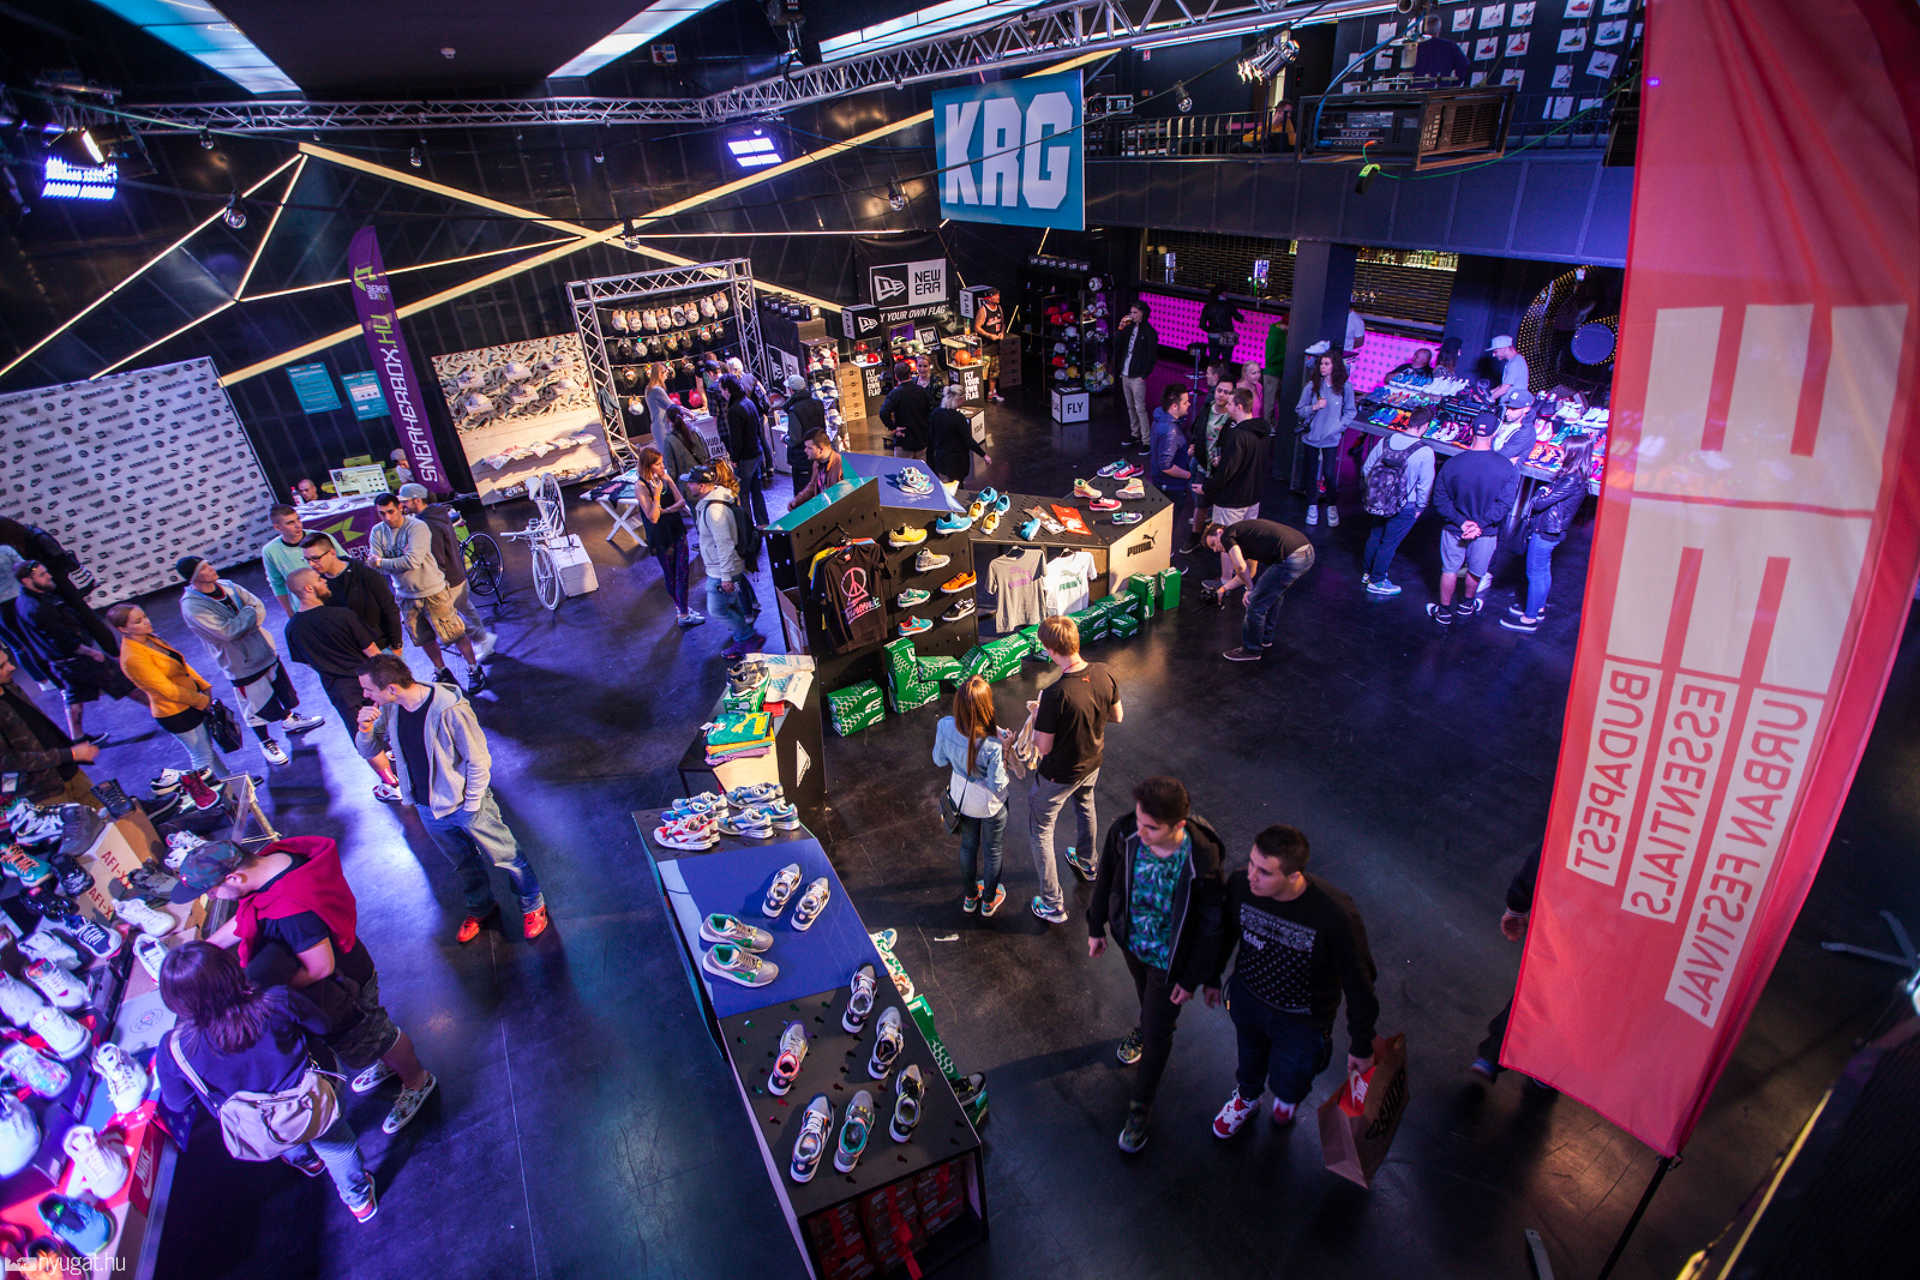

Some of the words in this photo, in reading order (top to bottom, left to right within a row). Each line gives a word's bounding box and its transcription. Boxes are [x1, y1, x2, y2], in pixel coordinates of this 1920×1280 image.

[946, 92, 1072, 209] KRG
[914, 268, 941, 283] NEW
[915, 281, 941, 296] ERA
[887, 309, 908, 322] YOUR
[909, 308, 927, 320] OWN
[928, 305, 946, 317] FLAG
[1067, 402, 1084, 415] FLY
[1127, 540, 1153, 558] PUMA
